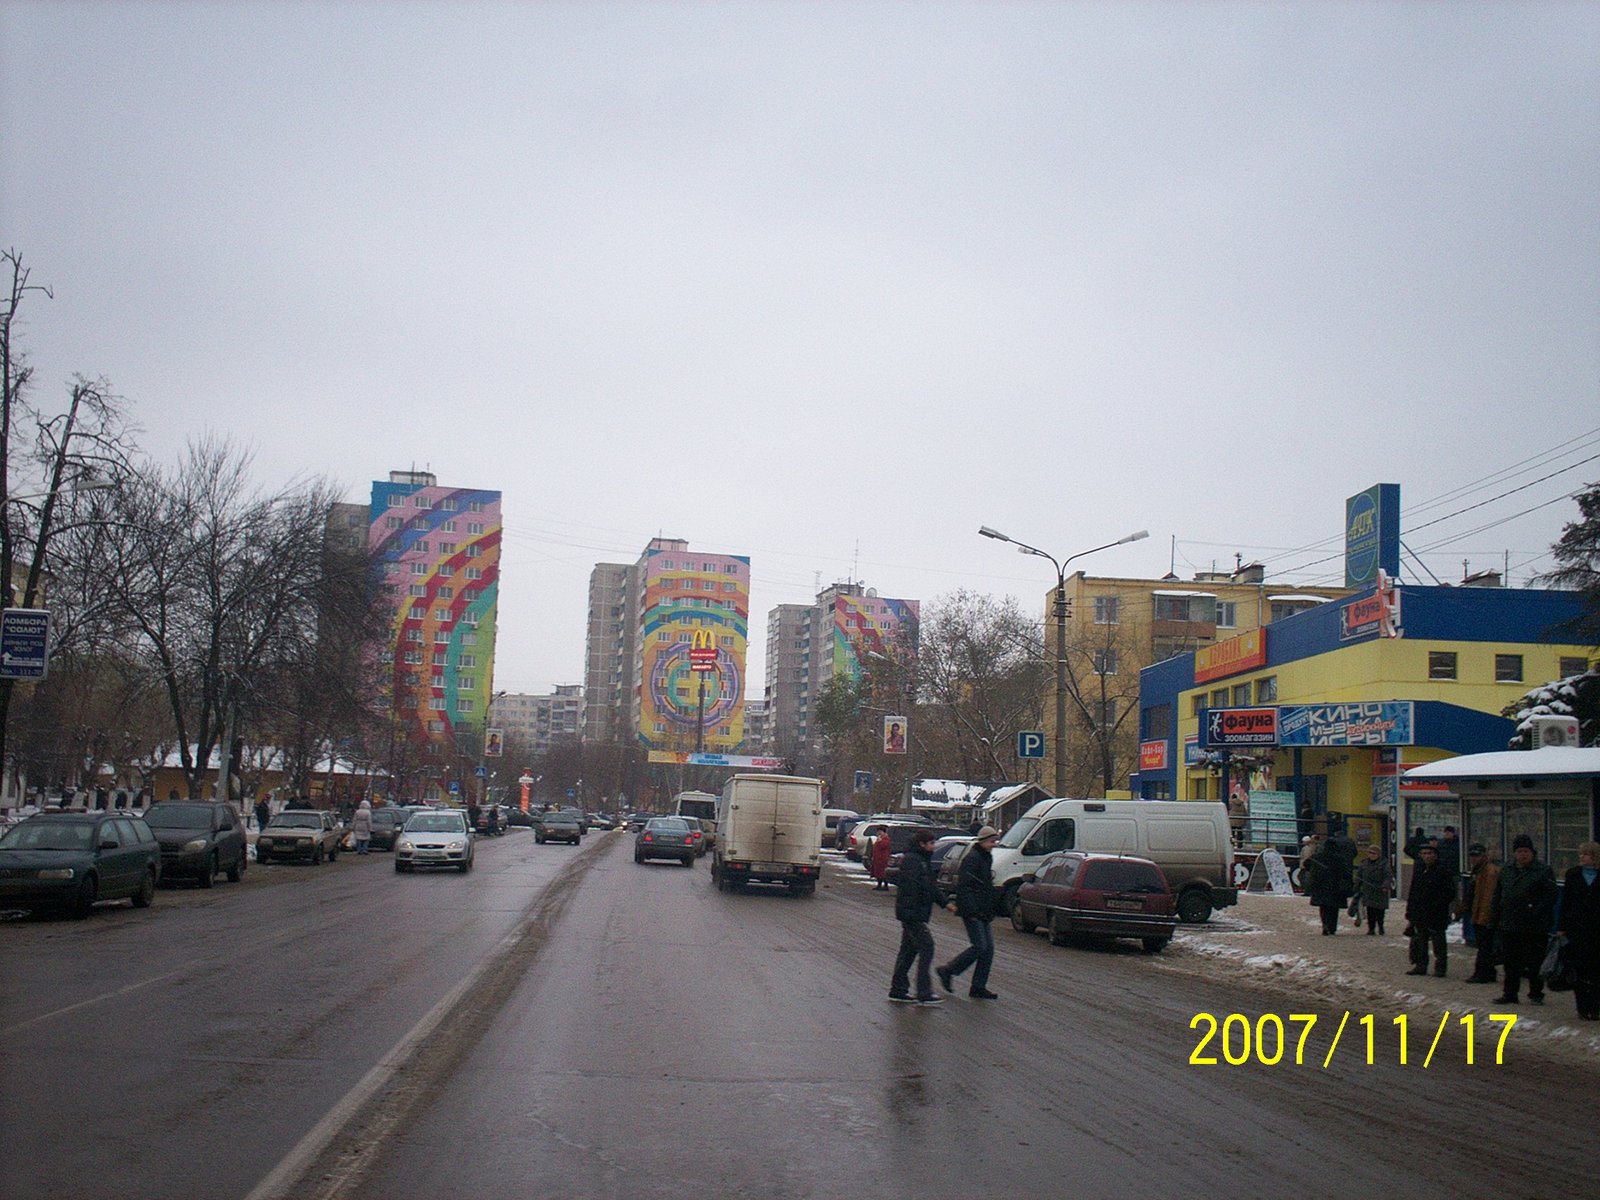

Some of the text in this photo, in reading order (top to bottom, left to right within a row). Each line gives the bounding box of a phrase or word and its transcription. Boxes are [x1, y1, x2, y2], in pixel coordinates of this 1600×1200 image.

[1309, 703, 1383, 725] КИНО
[1309, 717, 1382, 737] МУЗЫКА
[1025, 734, 1040, 756] P
